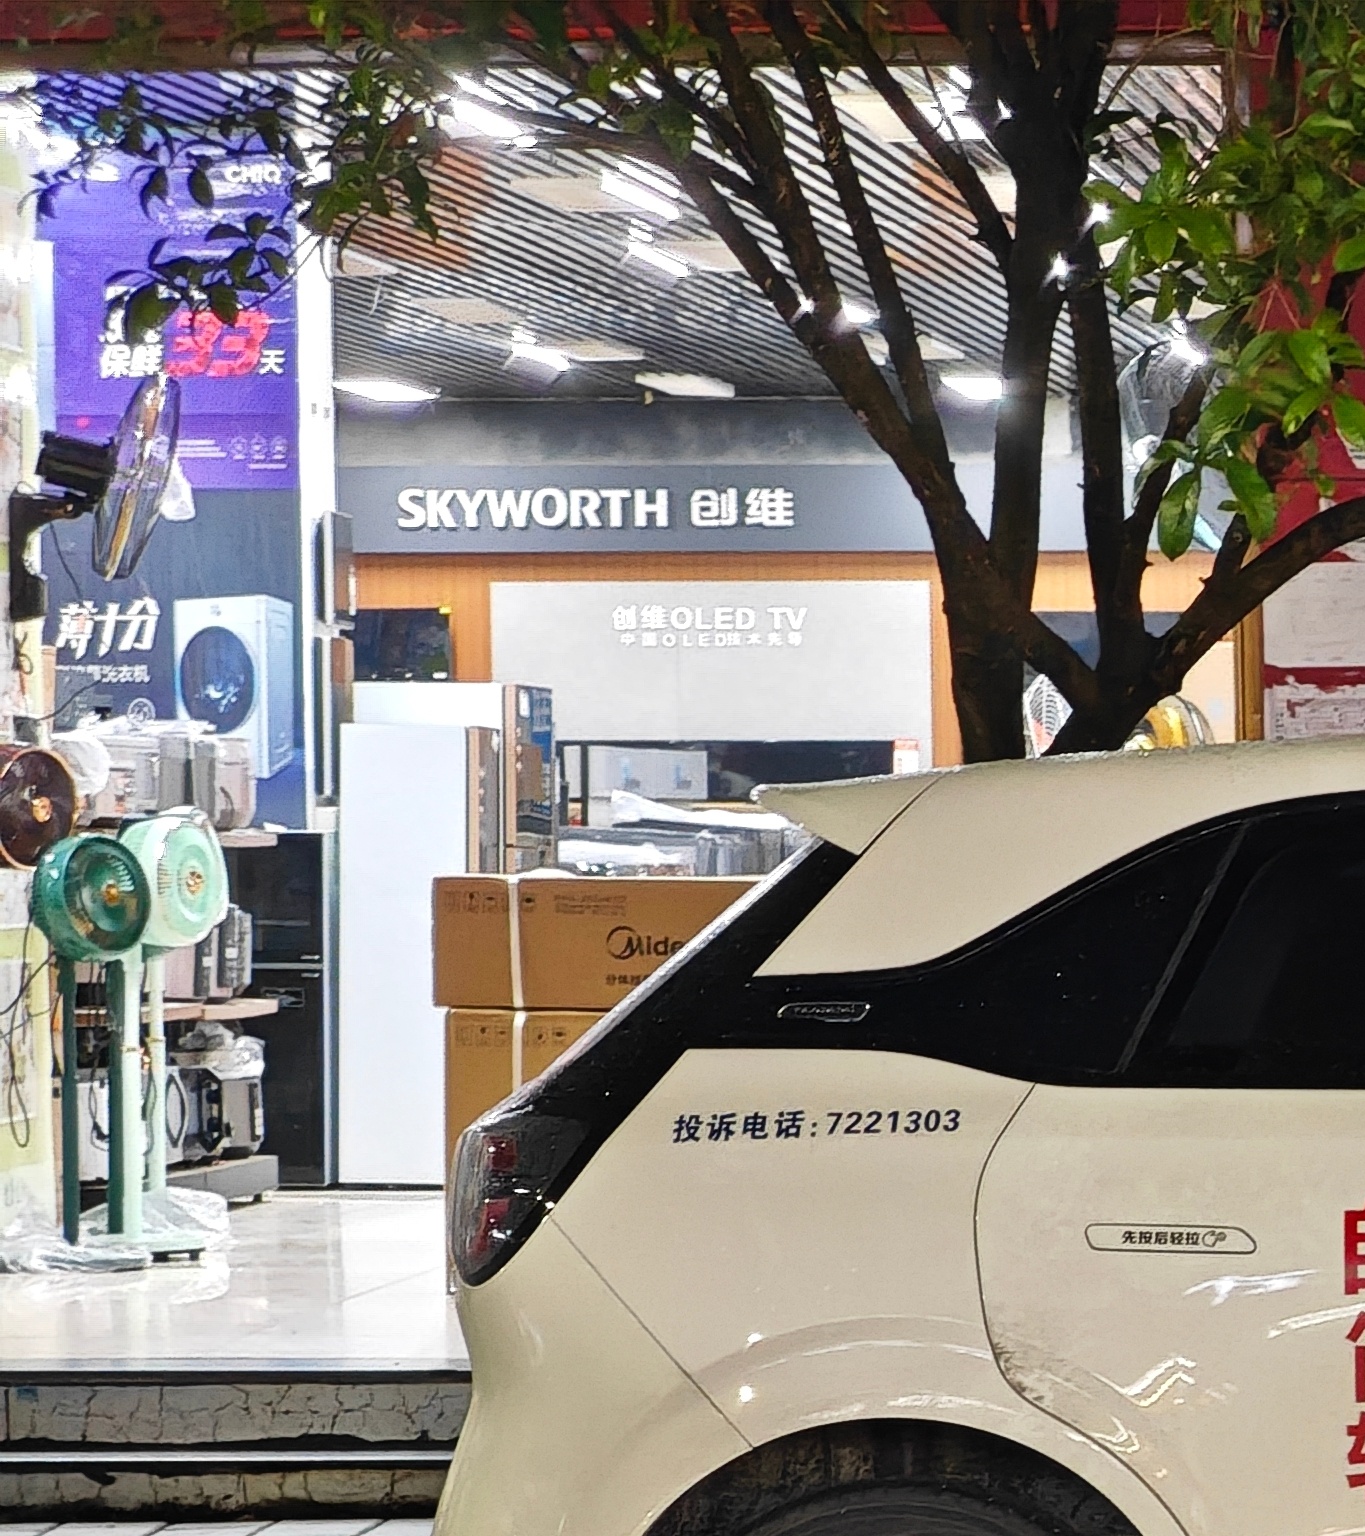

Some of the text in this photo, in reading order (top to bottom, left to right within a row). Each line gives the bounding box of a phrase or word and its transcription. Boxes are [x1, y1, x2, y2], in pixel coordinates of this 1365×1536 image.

[397, 486, 796, 529] SKYWORTH 创维
[612, 605, 808, 631] 创维OLED TV
[606, 926, 688, 960] Mide
[672, 1108, 962, 1144] 投诉电话:7221303
[1121, 1230, 1201, 1246] 先按后轻拉
